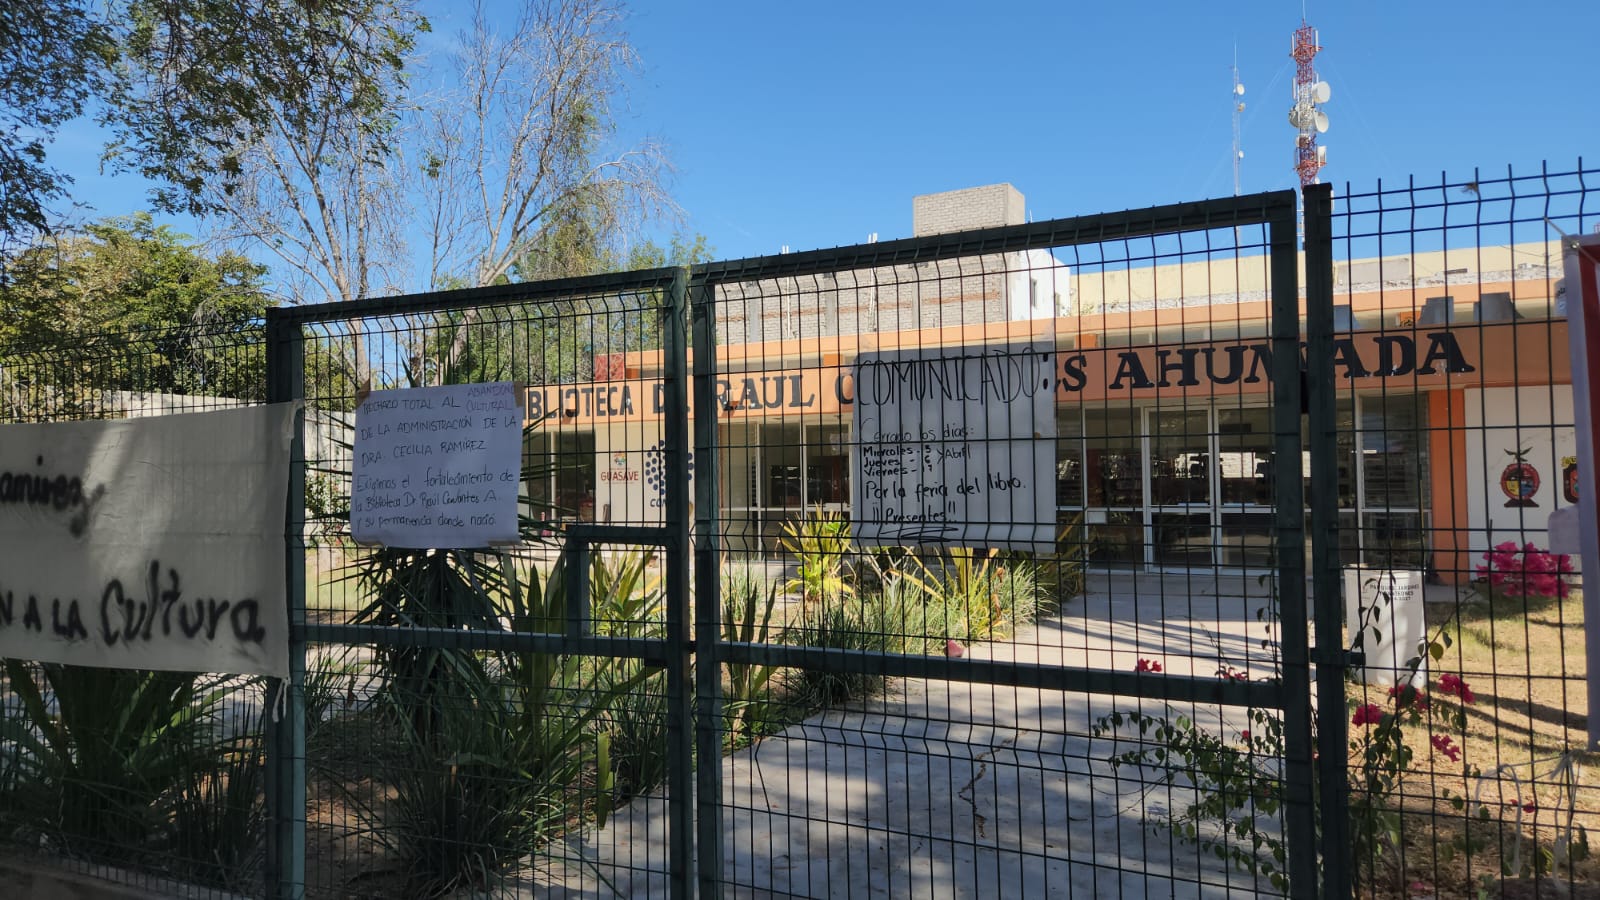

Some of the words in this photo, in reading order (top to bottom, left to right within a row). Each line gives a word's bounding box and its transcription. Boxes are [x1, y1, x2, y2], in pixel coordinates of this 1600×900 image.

[857, 346, 1049, 405] COMUNICADO:
[363, 399, 399, 415] RECHAZO
[403, 399, 433, 411] TOTAL
[441, 396, 461, 408] AL
[466, 400, 513, 413] CULTURAL
[522, 385, 634, 420] IBLIOTECA
[653, 383, 691, 414] D.
[716, 375, 815, 411] RAUL
[361, 427, 374, 441] DE
[378, 422, 391, 436] LA
[484, 417, 497, 429] DE
[505, 416, 517, 428] LA
[860, 417, 912, 442] Cerrado
[919, 422, 937, 441] los
[361, 451, 386, 468] DRA.
[393, 444, 433, 458] CECILIA
[864, 456, 900, 468] Jueves
[945, 444, 971, 459] Abril
[402, 475, 410, 488] el
[424, 464, 493, 488] fortalecimiento
[499, 468, 515, 483] de
[600, 470, 639, 481] GUASAVE
[864, 465, 909, 477] Viernes
[0, 454, 105, 539] amirez
[355, 499, 362, 513] la
[442, 489, 480, 506] Cervantes
[865, 480, 889, 499] Por
[892, 480, 907, 499] la
[915, 481, 949, 502] feria
[956, 477, 981, 496] del
[365, 518, 376, 528] su
[379, 515, 432, 529] permanencia
[438, 512, 465, 527] donde
[23, 593, 42, 633] A
[52, 598, 88, 639] LA
[100, 559, 266, 646] Cultura
